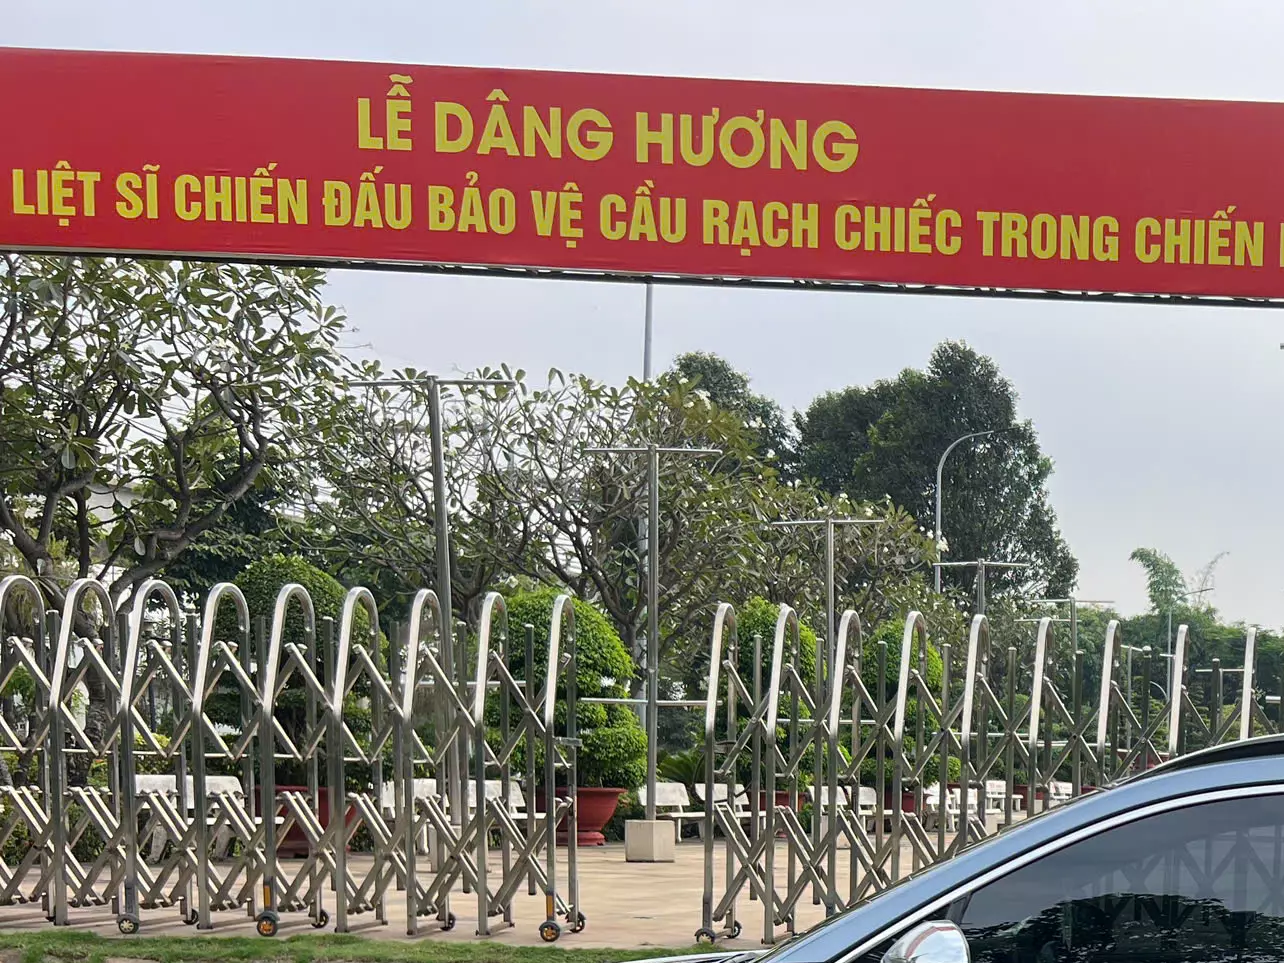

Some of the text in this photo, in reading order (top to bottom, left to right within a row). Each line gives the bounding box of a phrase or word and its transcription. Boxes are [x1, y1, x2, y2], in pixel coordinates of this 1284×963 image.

[357, 73, 862, 173] LỄ DÂNG HƯƠNG
[12, 161, 101, 228] LIỆT
[115, 164, 161, 221] SĨ
[174, 162, 309, 226] CHIẾN
[322, 165, 413, 231] ĐẤU
[427, 171, 517, 236] BẢO
[529, 181, 585, 250] VỆ
[599, 179, 688, 245] CẦU
[702, 199, 820, 257] RẠCH
[834, 193, 963, 257] CHIẾC
[976, 210, 1120, 263] TRONG
[1134, 205, 1266, 268] CHIẾN
